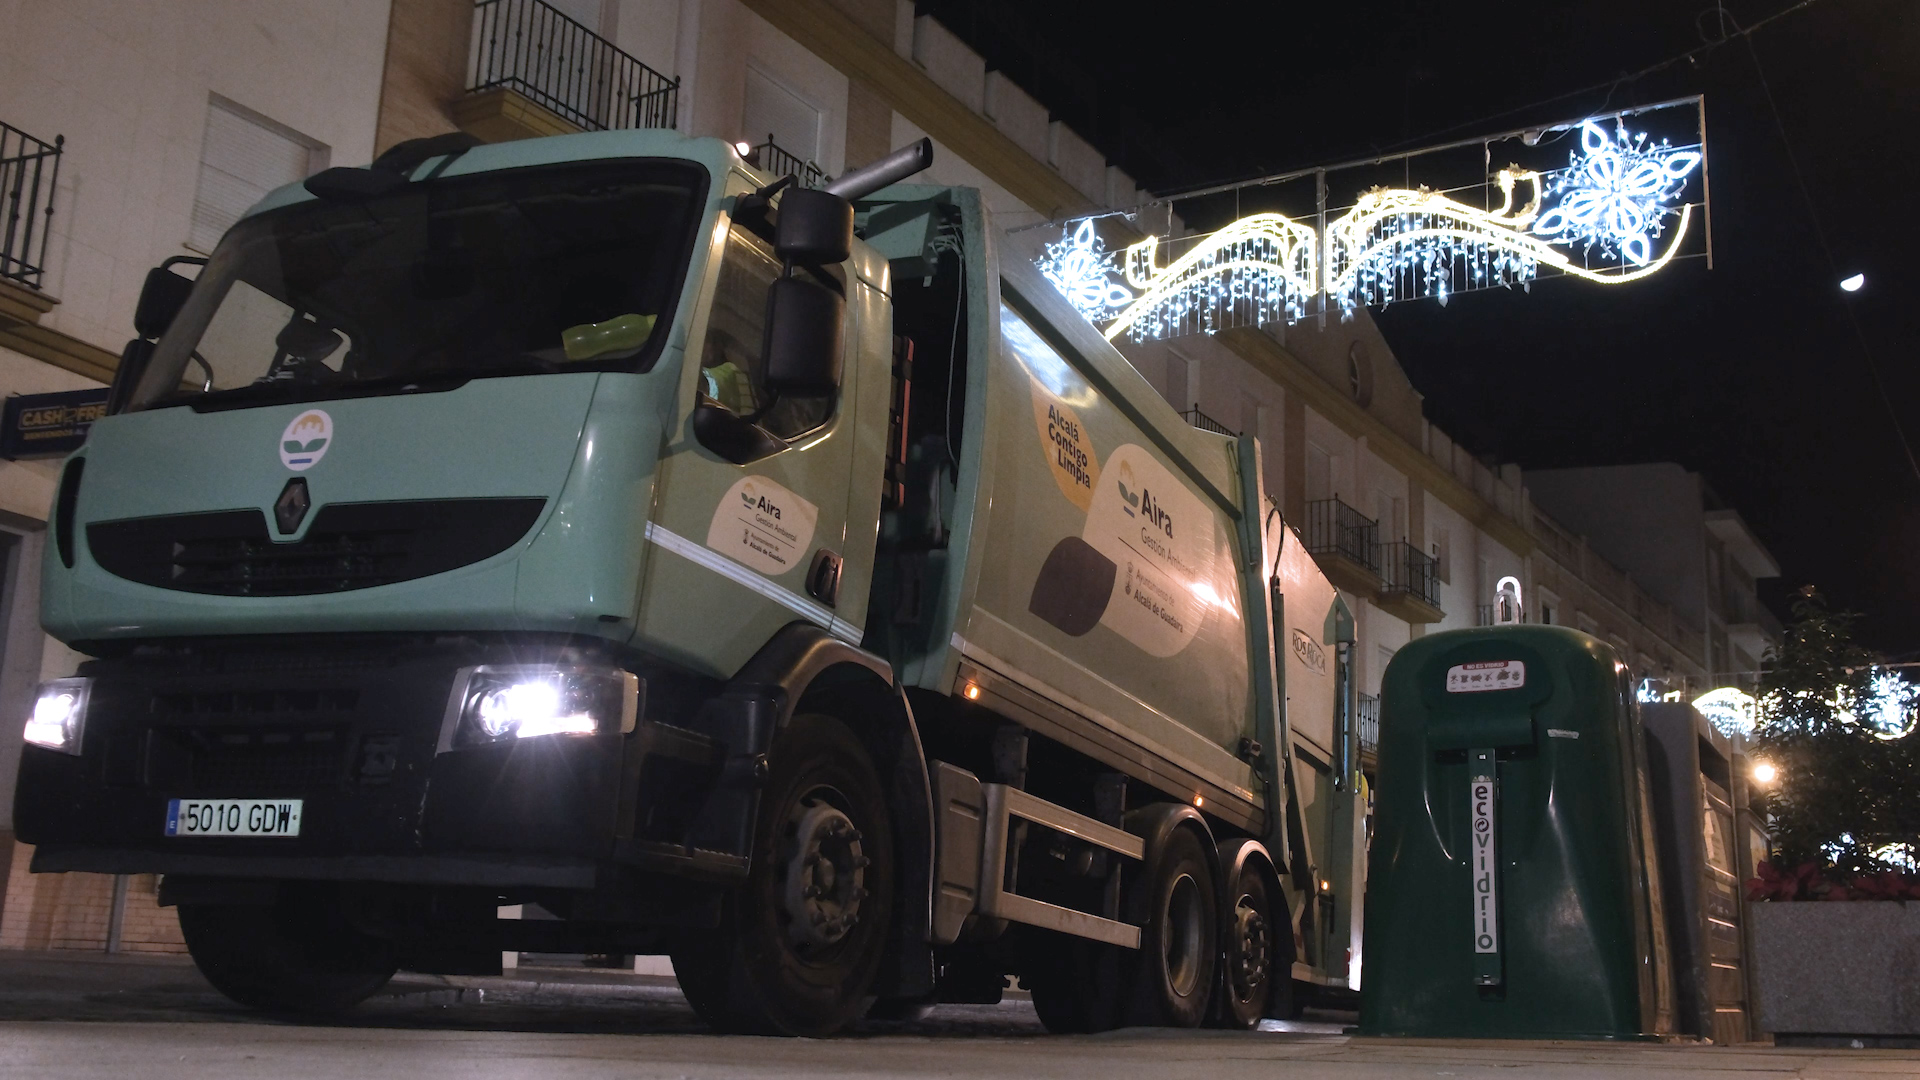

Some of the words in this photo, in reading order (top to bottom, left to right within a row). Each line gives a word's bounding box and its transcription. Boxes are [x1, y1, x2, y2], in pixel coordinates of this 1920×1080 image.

[22, 410, 62, 427] CASH
[1048, 404, 1079, 443] Alcalá
[1048, 423, 1088, 468] Contigo
[1057, 448, 1091, 489] Limpia
[757, 495, 781, 520] Aira
[1141, 488, 1173, 539] Aira
[1141, 527, 1166, 560] Gestión
[1133, 589, 1152, 610] Alcalá
[1152, 602, 1160, 616] de
[1292, 632, 1307, 655] ROS
[1306, 643, 1326, 673] ROCA
[169, 820, 176, 829] E
[187, 804, 241, 832] 5010
[249, 804, 292, 833] GDW
